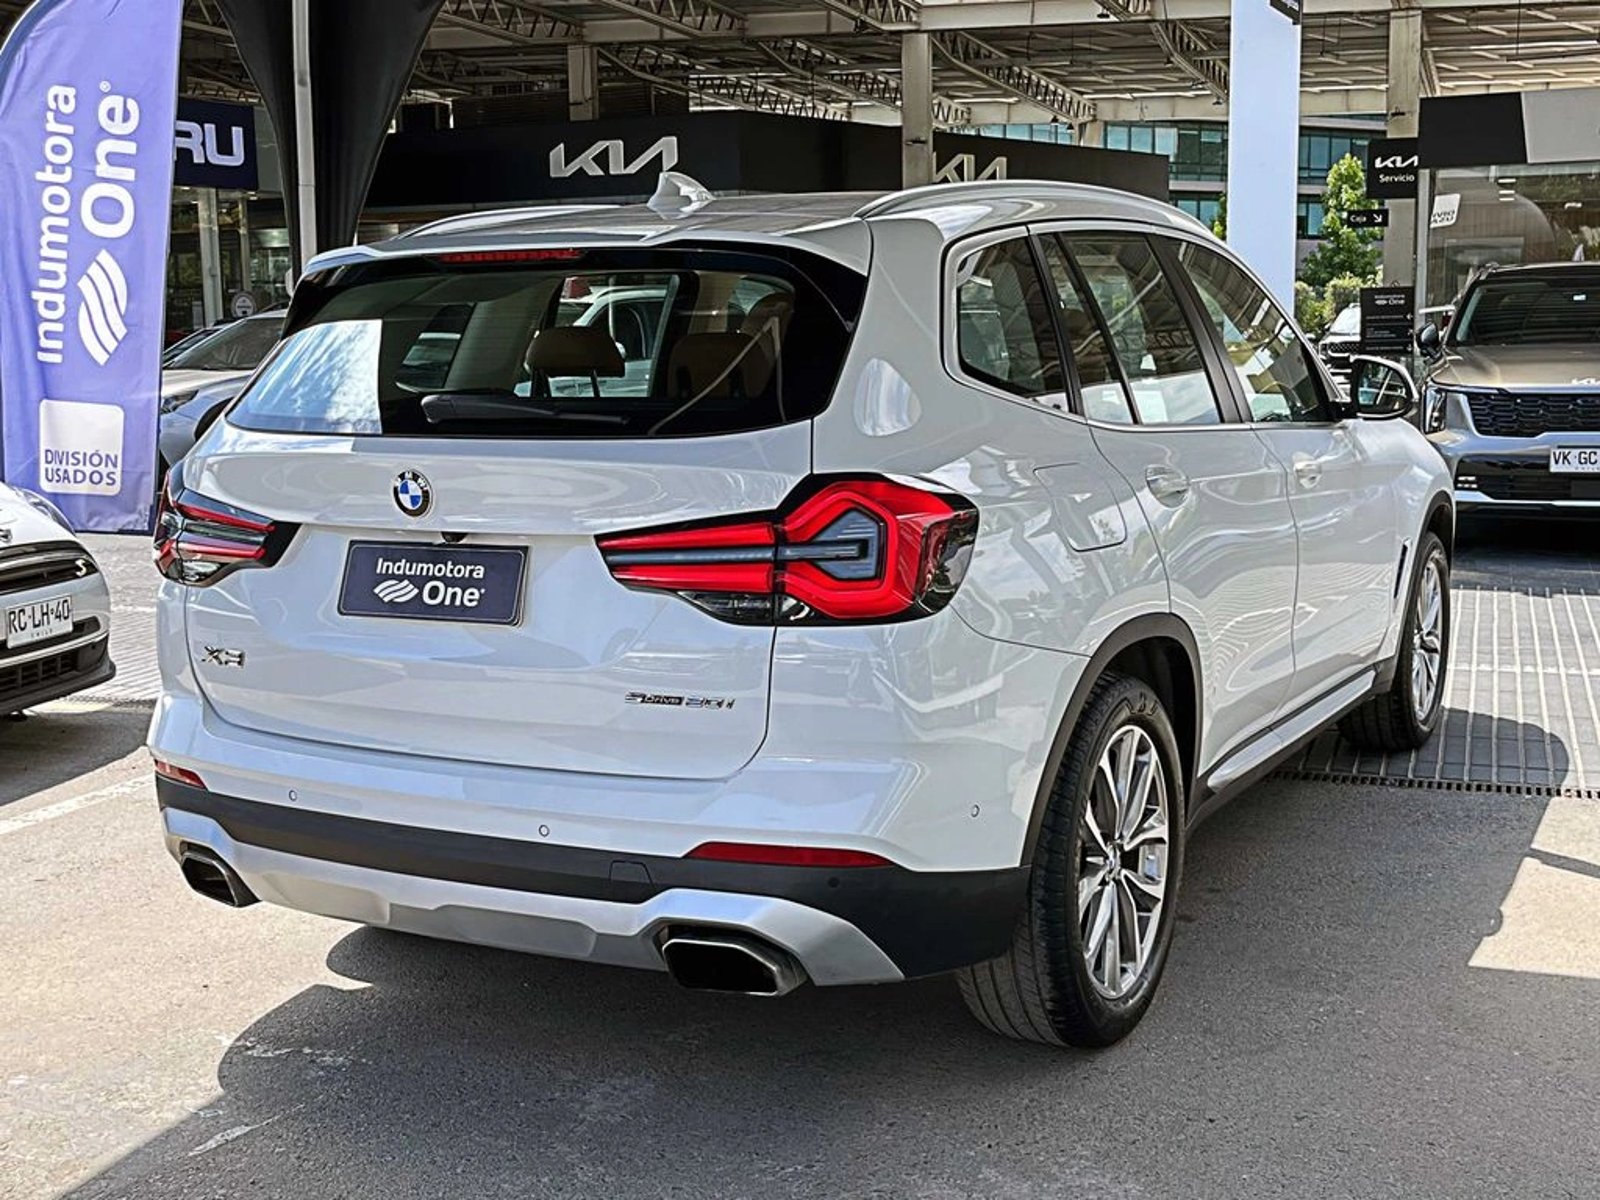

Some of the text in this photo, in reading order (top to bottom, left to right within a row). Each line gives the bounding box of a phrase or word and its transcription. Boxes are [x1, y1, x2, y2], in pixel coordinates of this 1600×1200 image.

[549, 136, 678, 178] KIA
[1374, 155, 1419, 169] KIA
[1379, 173, 1416, 184] Servicio
[31, 84, 77, 364] Indumotora
[1349, 214, 1368, 224] Caja
[44, 449, 119, 469] DIVISIÓN
[44, 467, 117, 487] USADOS
[375, 557, 485, 579] Indumotora
[422, 580, 481, 607] One
